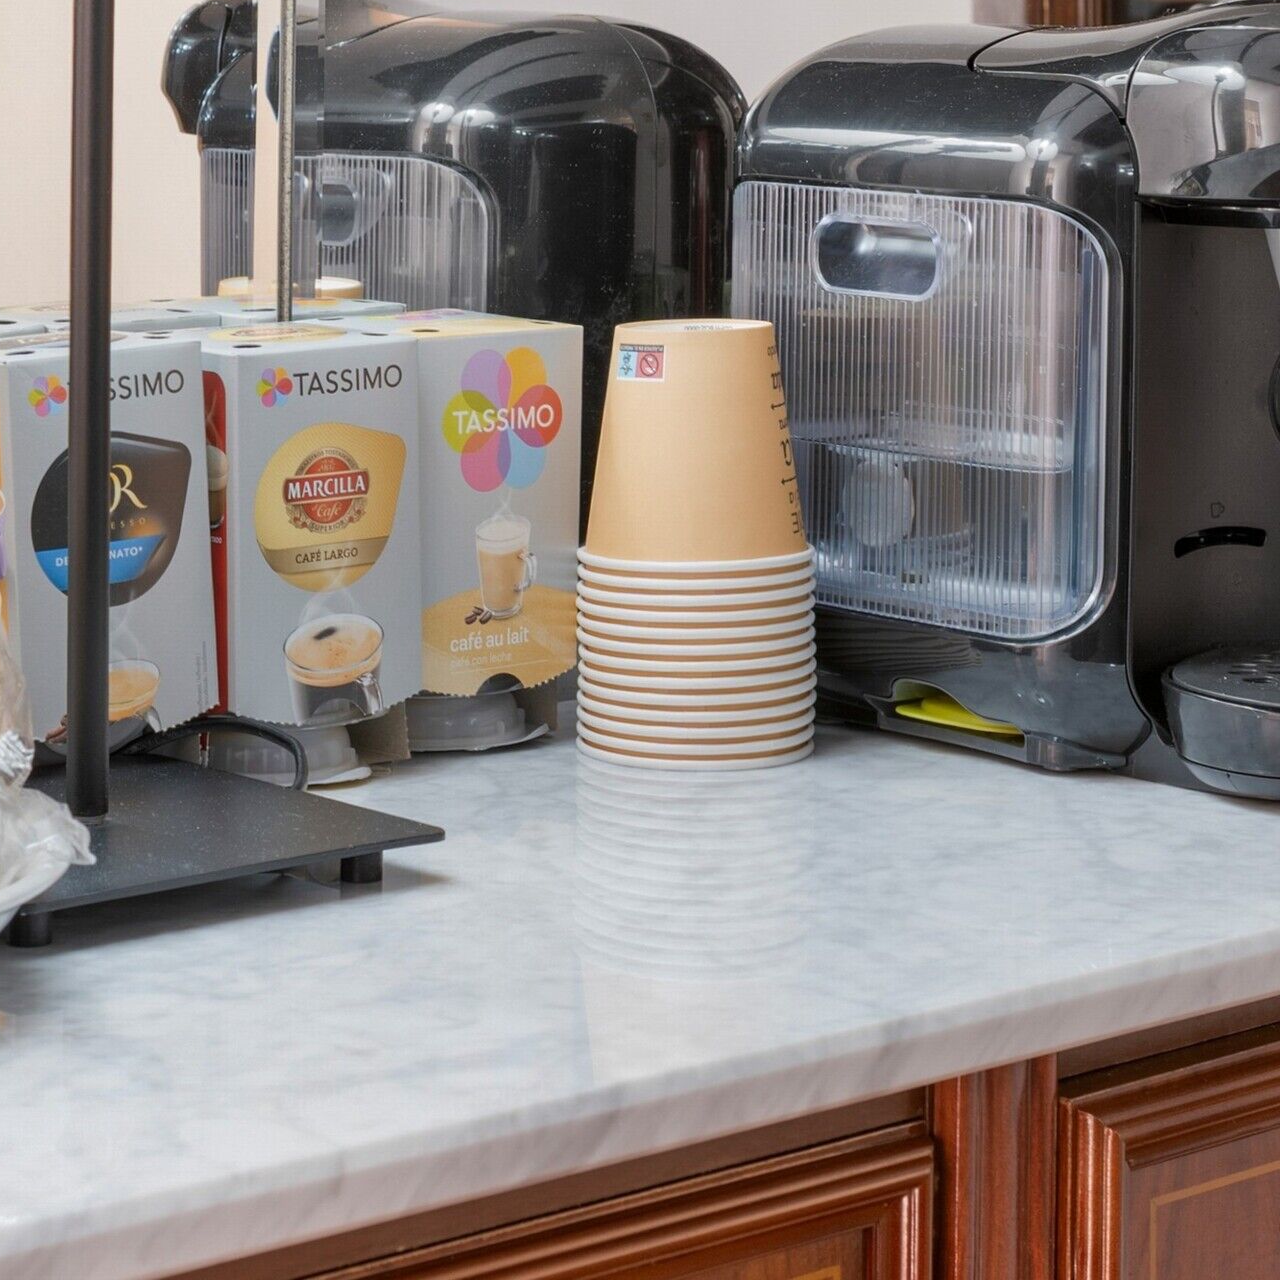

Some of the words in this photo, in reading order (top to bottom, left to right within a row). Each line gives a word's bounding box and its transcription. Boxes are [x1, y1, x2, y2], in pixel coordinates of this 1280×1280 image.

[293, 364, 403, 396] TASSIMO
[452, 404, 555, 435] TASSIMO
[287, 475, 366, 500] MARCILLA
[295, 549, 321, 564] CAFÉ
[324, 547, 359, 561] LARGO
[450, 632, 483, 652] café
[486, 633, 504, 648] au
[507, 627, 530, 645] lait
